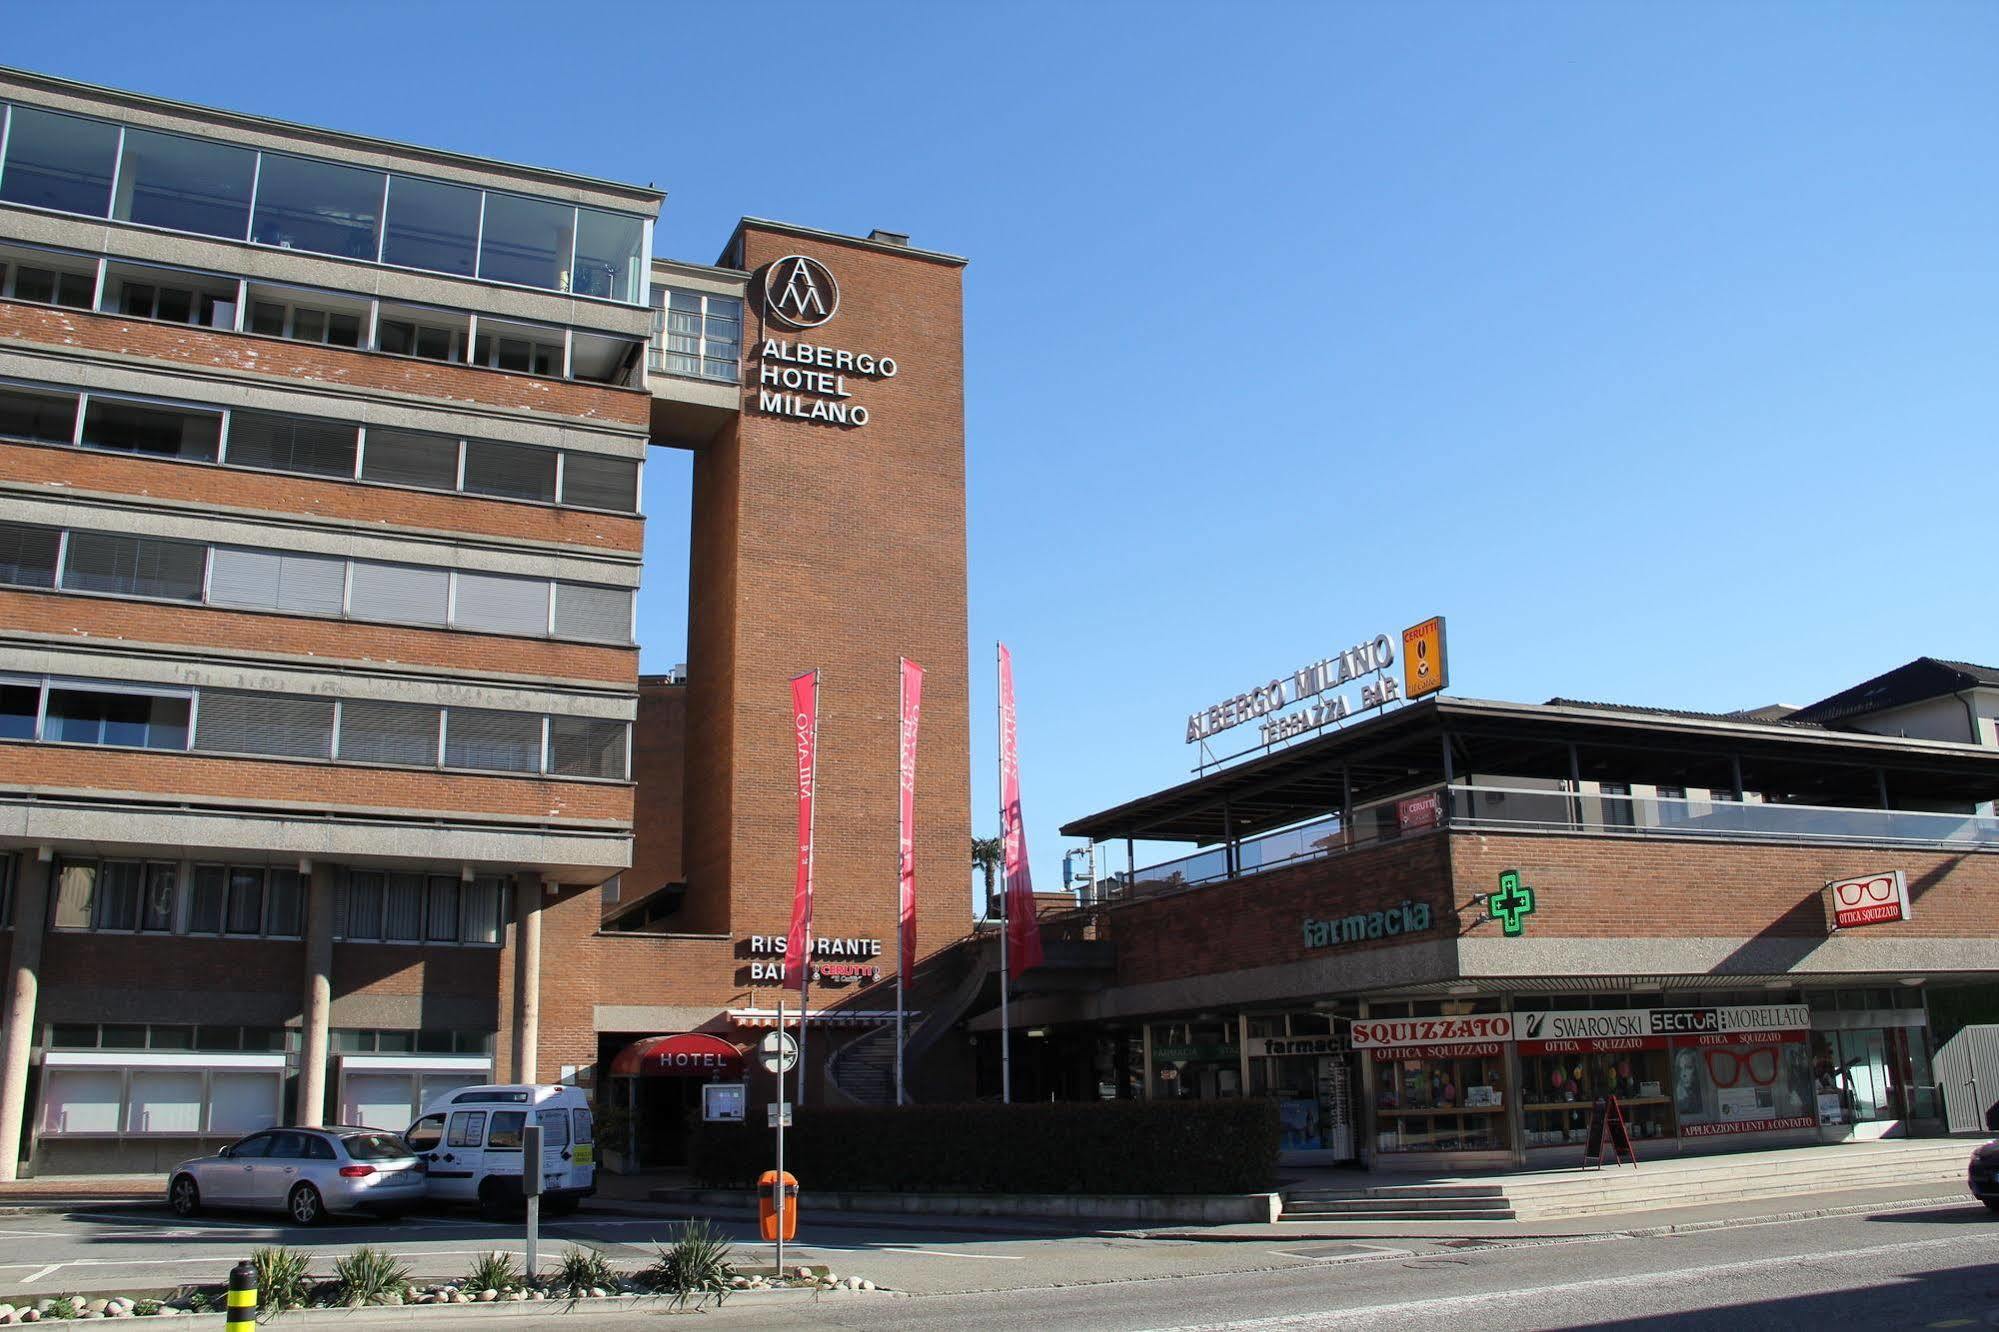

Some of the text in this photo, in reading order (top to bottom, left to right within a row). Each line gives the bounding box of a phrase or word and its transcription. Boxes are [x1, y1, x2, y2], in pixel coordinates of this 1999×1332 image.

[762, 338, 898, 378] ALBERGO
[761, 363, 853, 397] HOTEL
[760, 390, 870, 427] MILANO
[1404, 622, 1438, 643] CERUTTI
[1186, 633, 1395, 745] ALBERGO MILANO
[1257, 676, 1400, 746] TERRAZZA BAR
[1303, 901, 1430, 949] farmacia
[1839, 905, 1898, 925] OTTICA SQUIZZATO
[751, 935, 882, 956] RISRANTE
[820, 963, 873, 977] CERUTTI
[1553, 1014, 1643, 1038] SWAROVSKI
[1728, 1006, 1809, 1029] MORELLATO
[1353, 1017, 1510, 1044] SQUIZZATO
[1699, 1032, 1782, 1046] OTTICA SQUIZZATO
[1376, 1043, 1499, 1060] OTTICA SQUIZZATO
[1545, 1037, 1642, 1052] OTTICA SQUIZZATO
[660, 1053, 727, 1067] HOTEL
[1684, 1121, 1741, 1137] APPLICAZIONE
[1741, 1120, 1766, 1134] LENTI
[1774, 1116, 1813, 1130] CONTATTO
